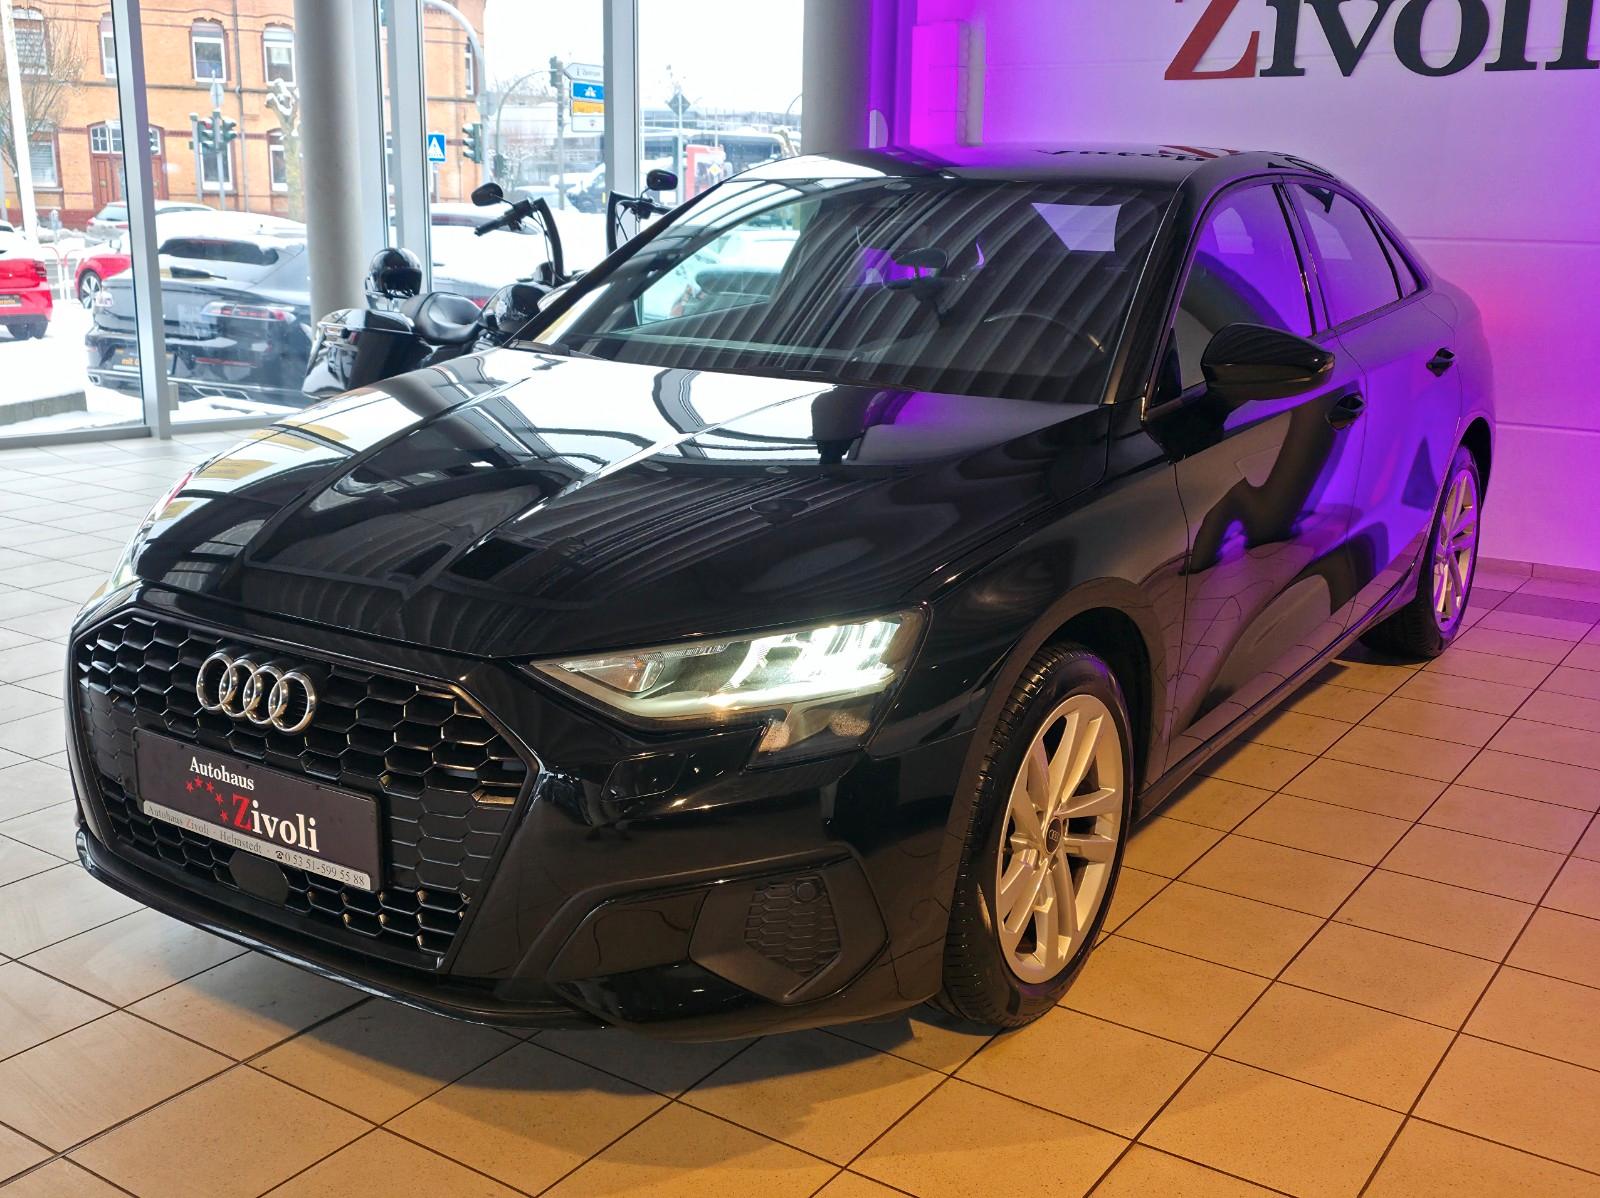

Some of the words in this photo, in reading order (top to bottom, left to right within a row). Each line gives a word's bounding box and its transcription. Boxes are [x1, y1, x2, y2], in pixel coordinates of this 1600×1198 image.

[189, 756, 255, 791] Autohaus
[147, 805, 184, 825] Autohaus
[184, 818, 210, 836] Zivoli
[219, 830, 262, 853] Helmstedt
[339, 869, 350, 881] 55
[353, 874, 365, 886] 88
[232, 793, 320, 853] Zivoli
